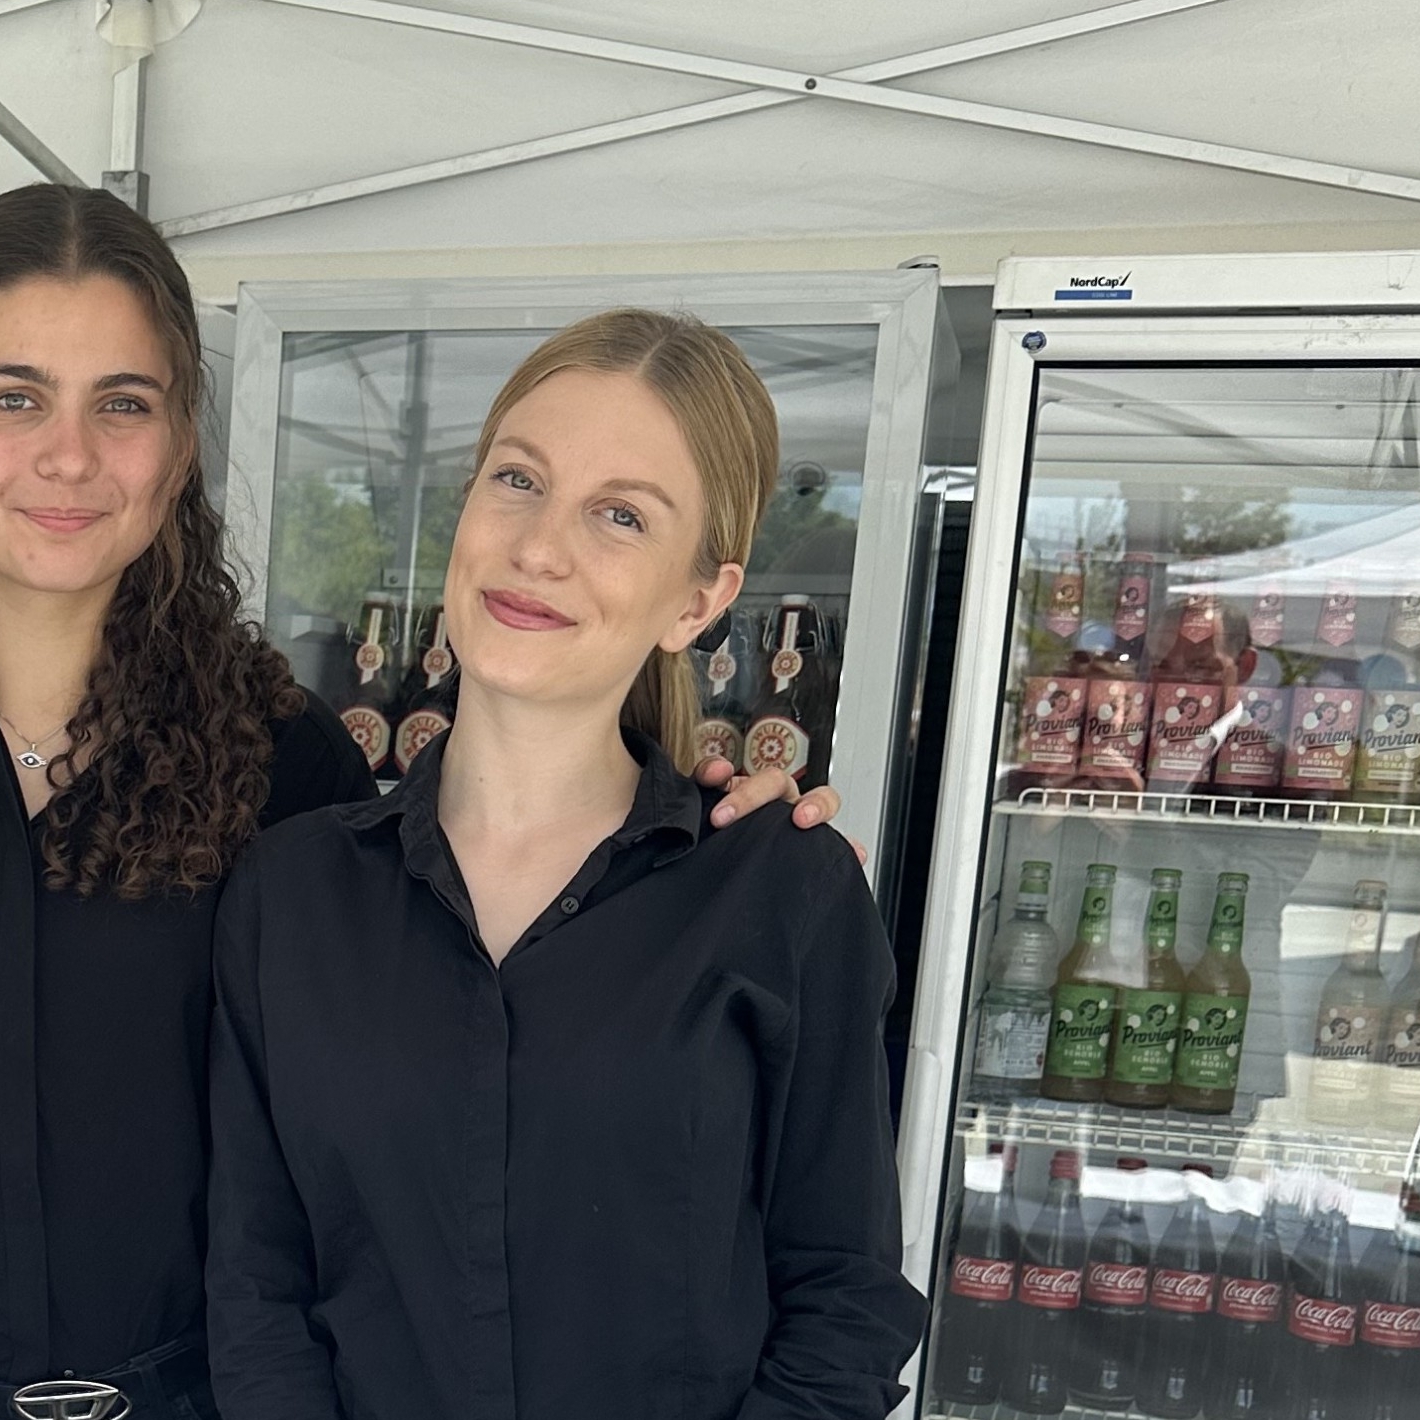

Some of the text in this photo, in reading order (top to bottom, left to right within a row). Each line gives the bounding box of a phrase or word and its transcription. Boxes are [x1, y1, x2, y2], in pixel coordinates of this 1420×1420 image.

[1070, 276, 1120, 288] NordCap
[955, 1258, 1013, 1285] Coca-Cola
[1023, 1266, 1081, 1293] Coca-Cola
[1090, 1263, 1147, 1289] Coca-Cola
[1152, 1269, 1211, 1297] Coca-Cola
[1223, 1279, 1280, 1306] Coca-Cola
[1295, 1299, 1357, 1329] Coca-Cola
